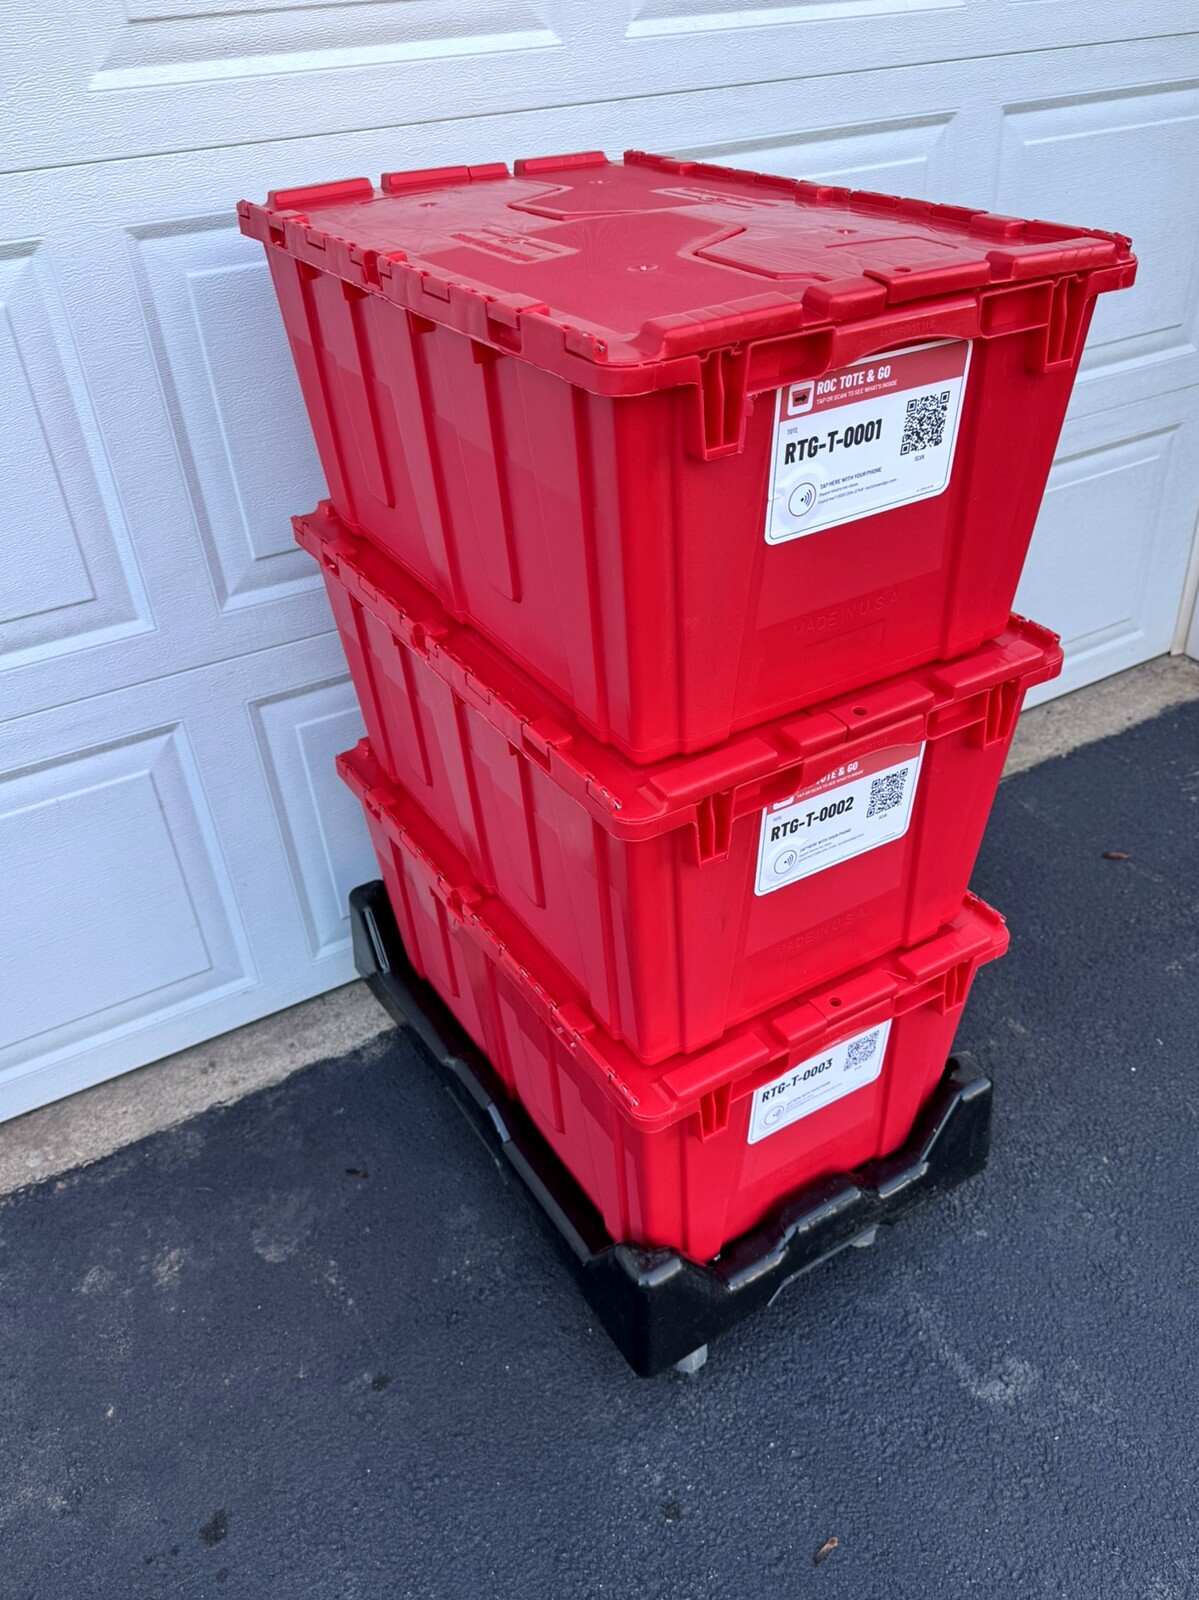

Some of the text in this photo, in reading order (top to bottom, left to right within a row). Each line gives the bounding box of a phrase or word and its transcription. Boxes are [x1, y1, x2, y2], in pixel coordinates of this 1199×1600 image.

[816, 365, 891, 395] ROC TOTE & GO
[784, 418, 882, 465] RTG-T-0001
[828, 479, 841, 488] HERE
[841, 475, 854, 484] WITH
[846, 761, 859, 773] GO
[770, 796, 855, 842] RTG-T-0002
[762, 1057, 833, 1103] RTG-T-0003
